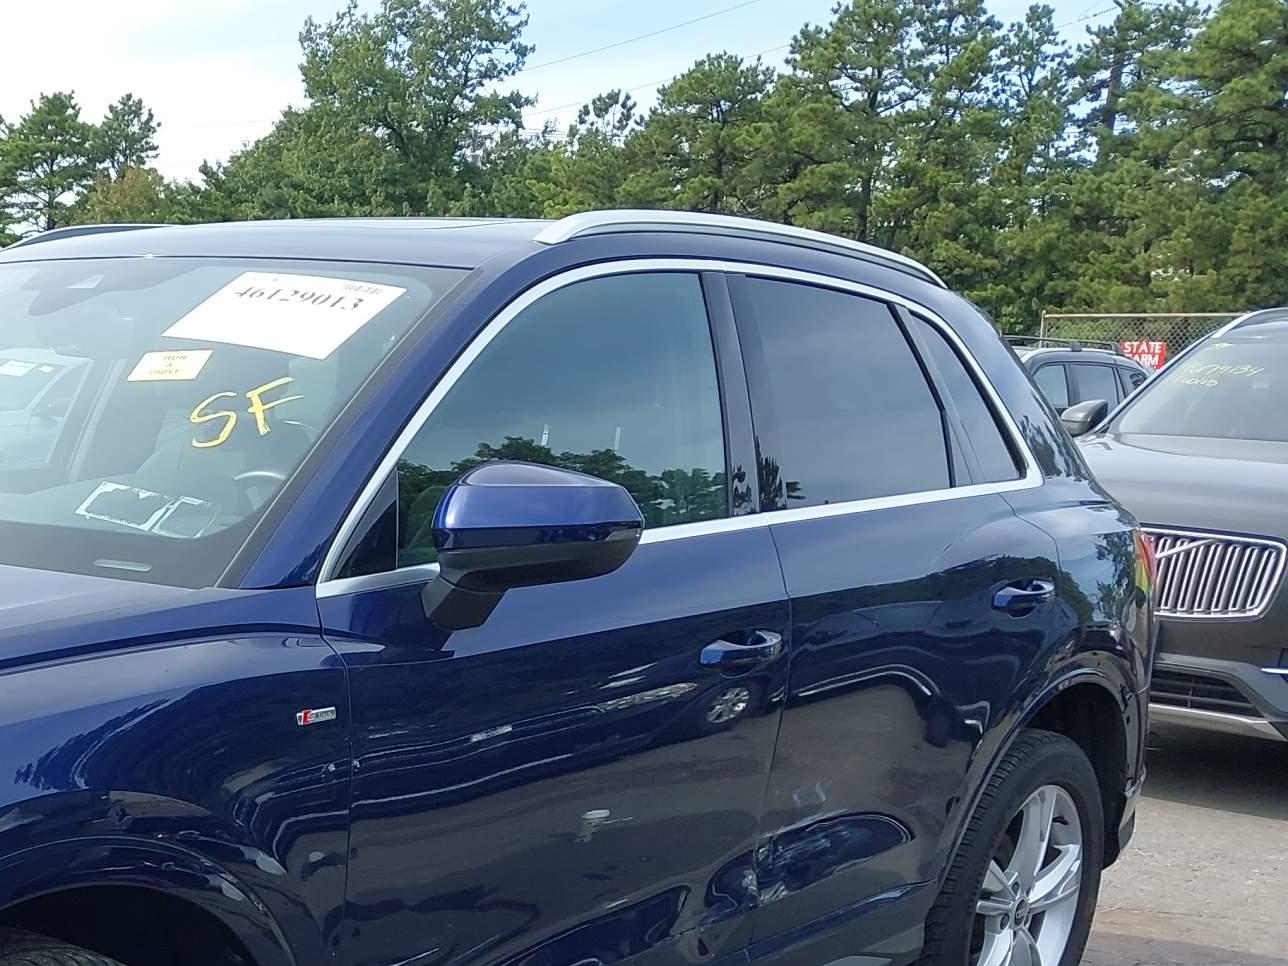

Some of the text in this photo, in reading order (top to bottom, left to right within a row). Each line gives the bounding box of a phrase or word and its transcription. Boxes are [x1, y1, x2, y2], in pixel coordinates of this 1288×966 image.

[234, 285, 364, 310] 46129013
[1123, 340, 1163, 354] STATE
[189, 375, 305, 448] SF
